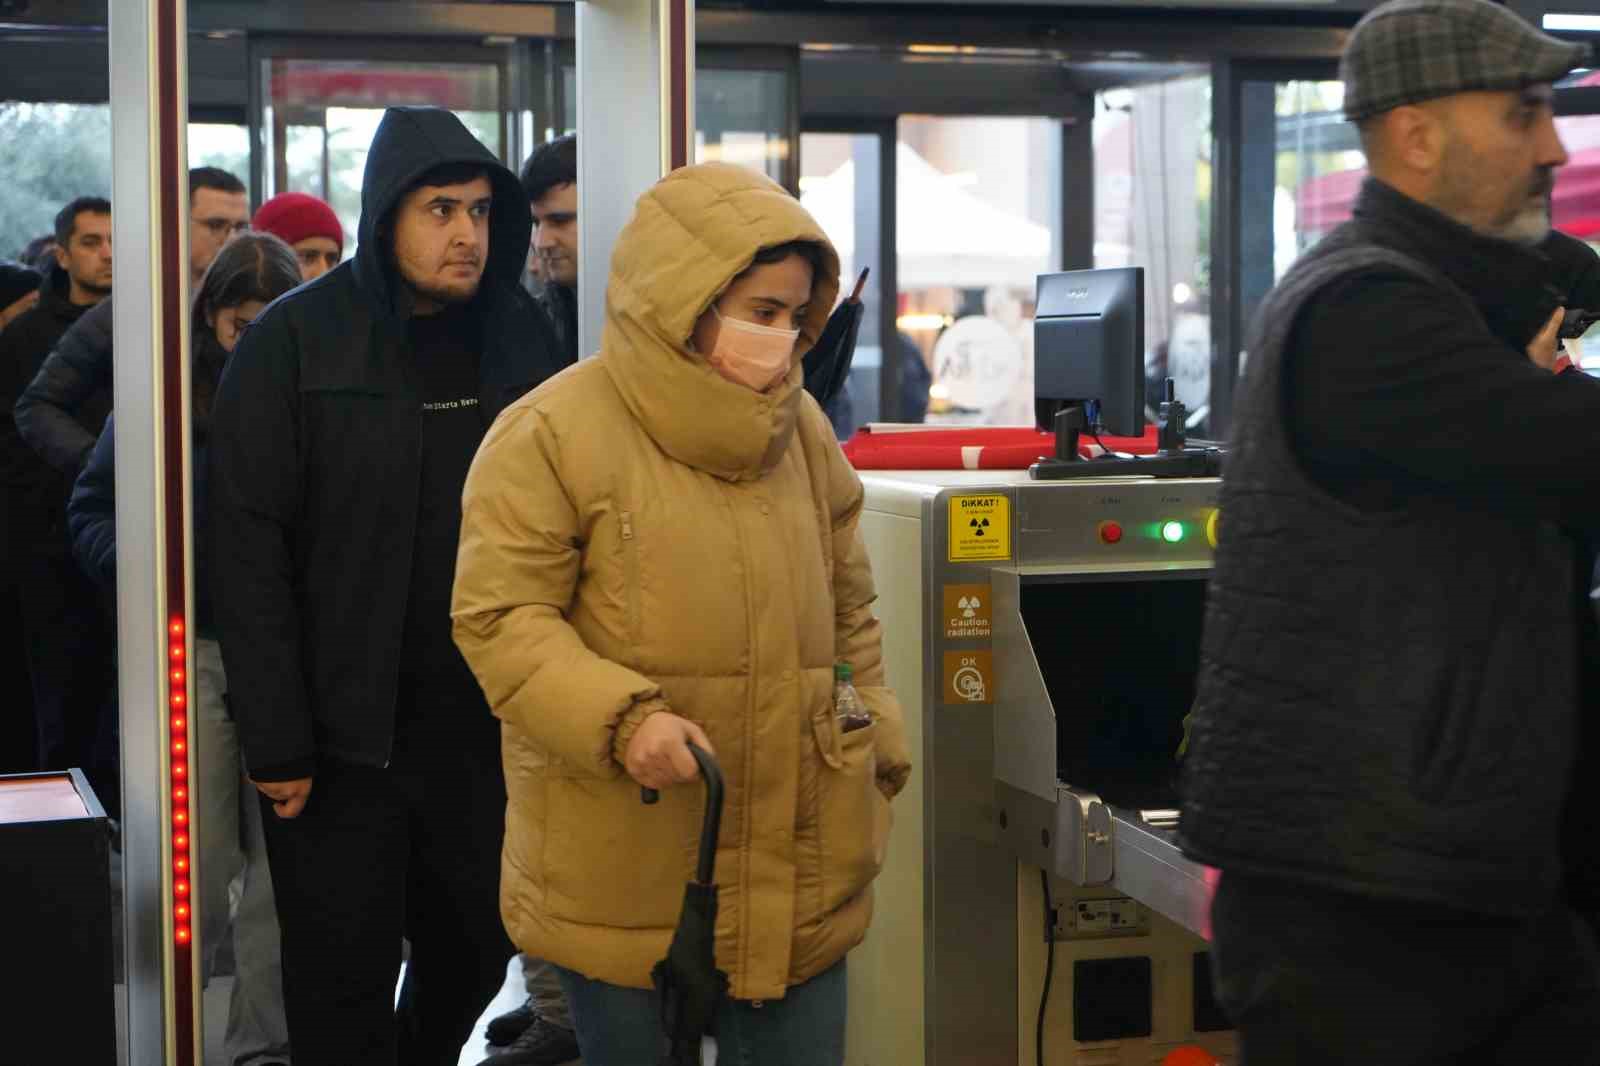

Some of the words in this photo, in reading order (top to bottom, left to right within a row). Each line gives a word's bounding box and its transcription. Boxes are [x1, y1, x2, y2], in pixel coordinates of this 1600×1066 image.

[950, 618, 988, 627] Caution
[947, 628, 991, 637] radiation
[961, 657, 977, 666] OK
